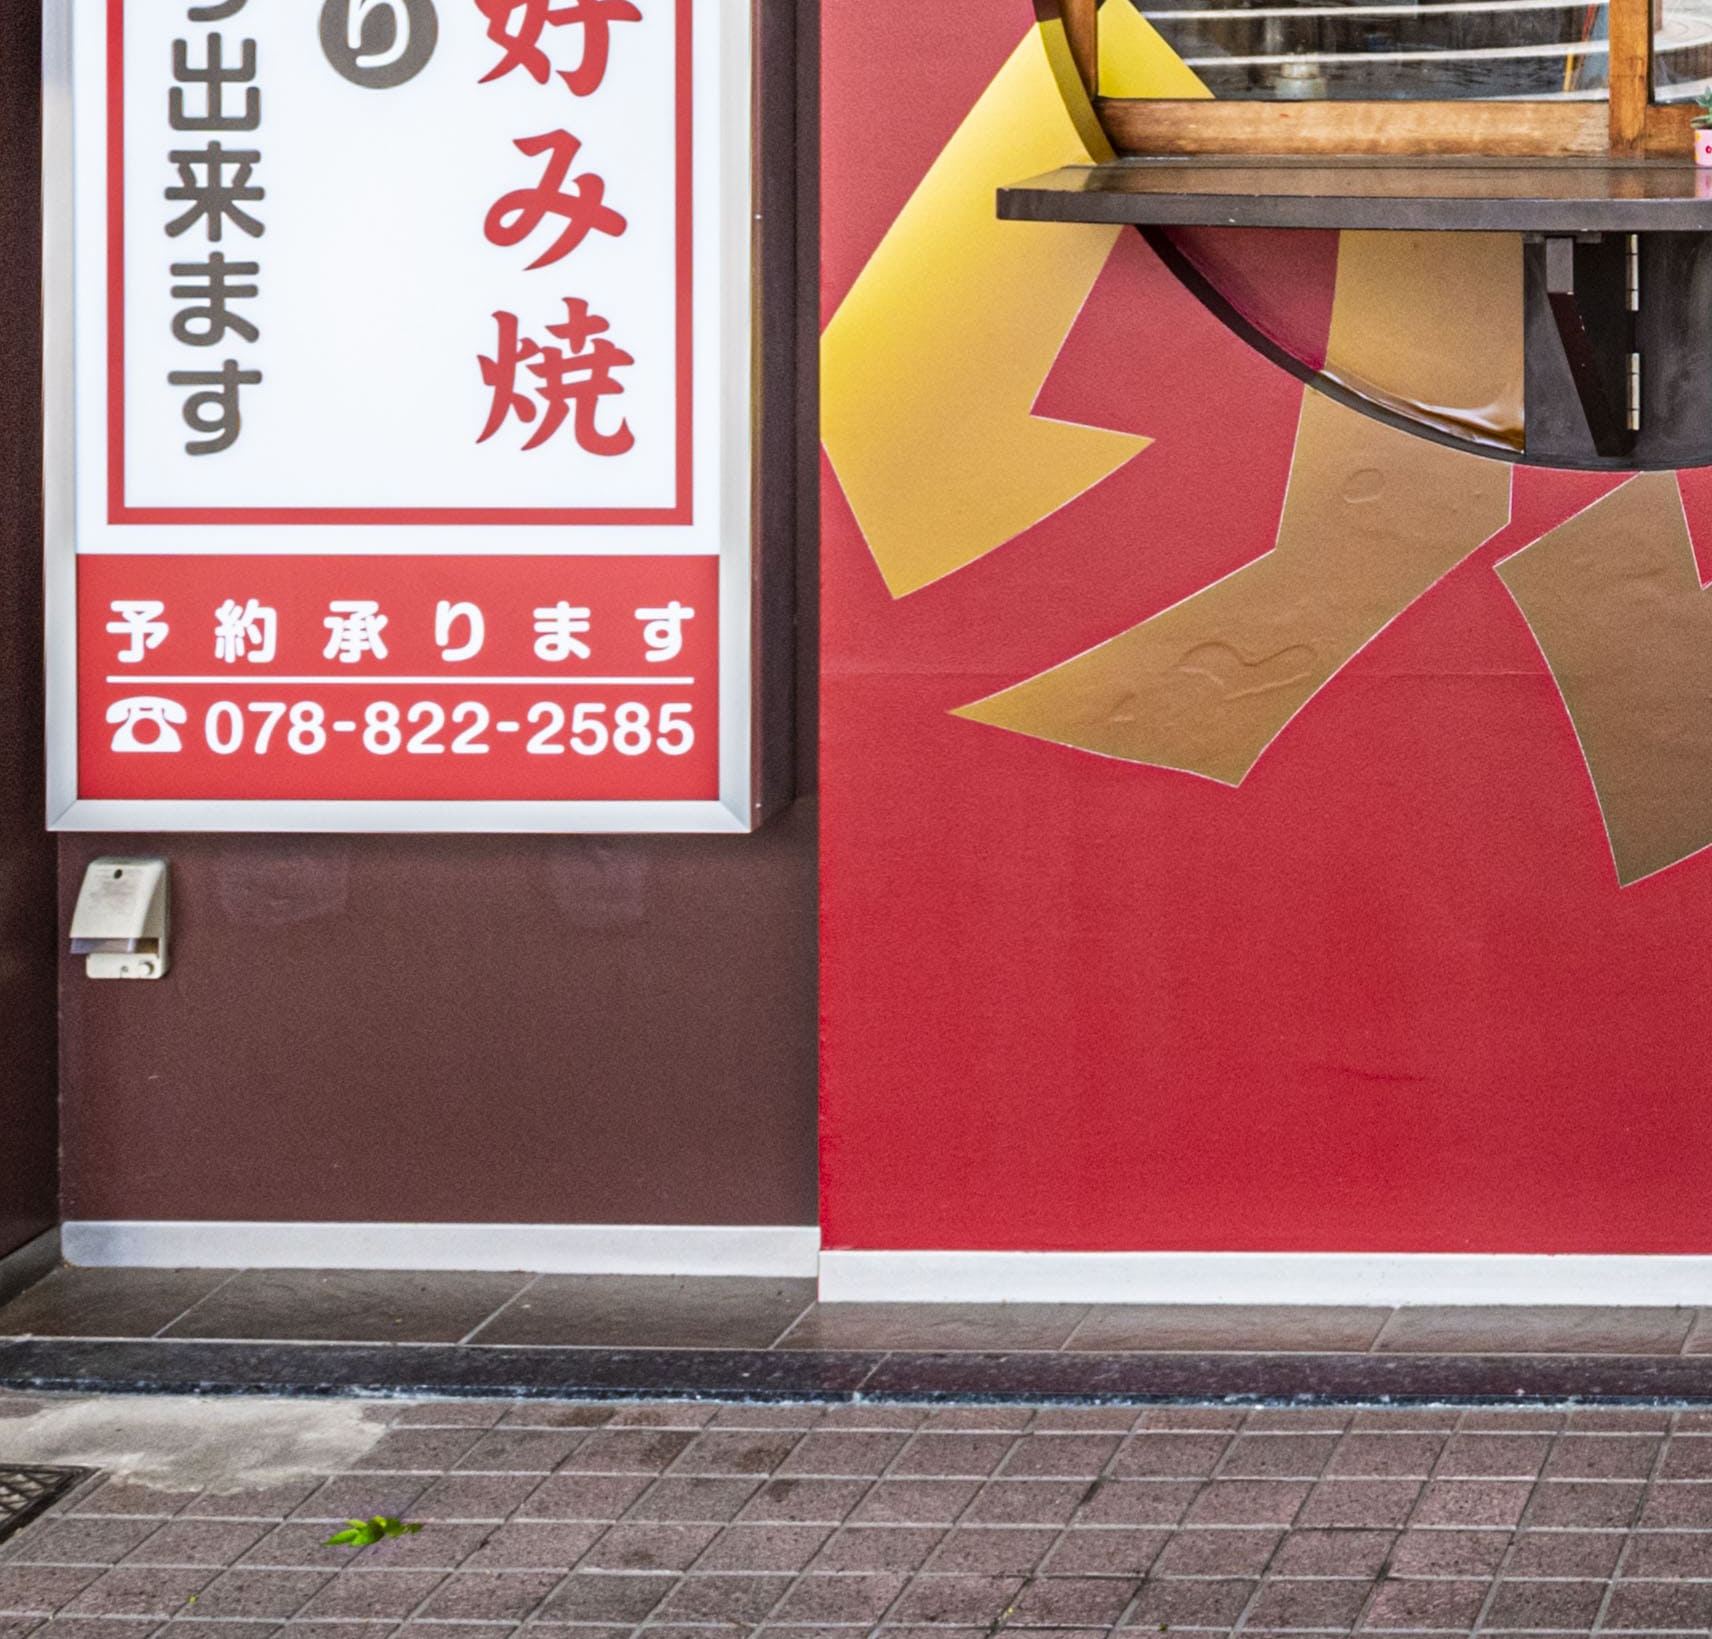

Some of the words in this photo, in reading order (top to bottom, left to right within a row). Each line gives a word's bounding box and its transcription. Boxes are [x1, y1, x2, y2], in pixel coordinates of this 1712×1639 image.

[105, 599, 696, 664] 予約承ります
[203, 700, 696, 756] 078-822-2585
